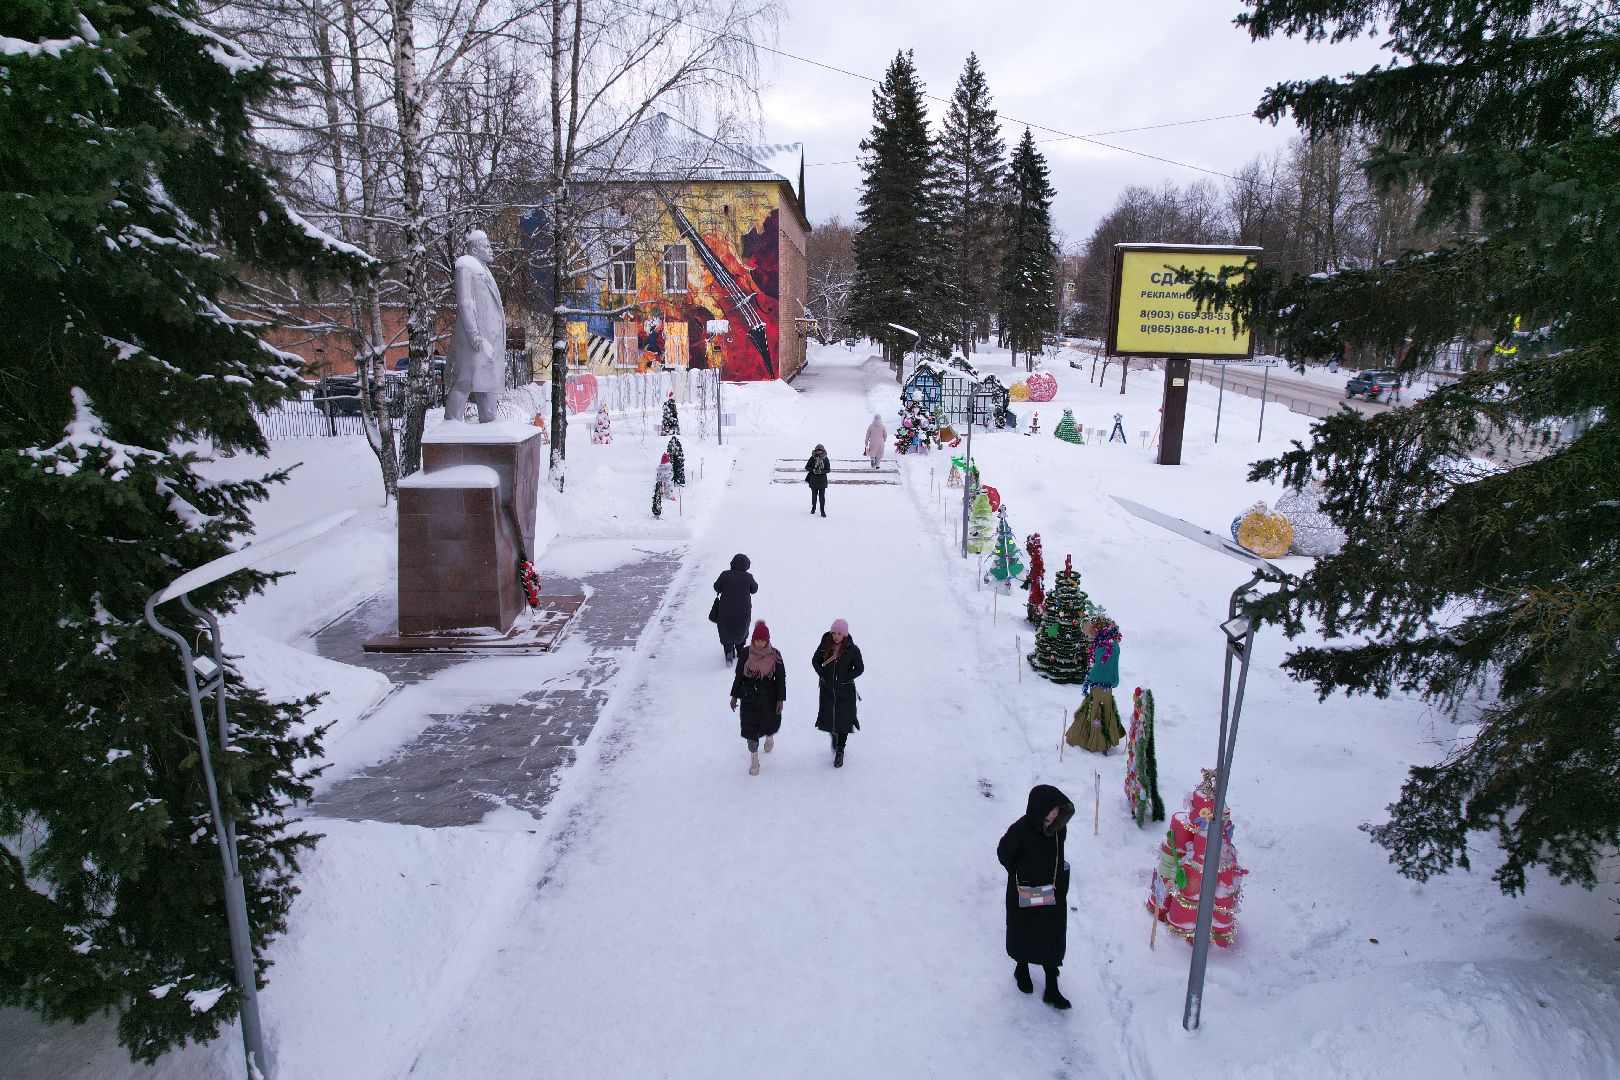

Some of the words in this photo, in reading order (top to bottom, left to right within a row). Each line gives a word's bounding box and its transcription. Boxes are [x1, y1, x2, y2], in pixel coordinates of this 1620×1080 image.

[1140, 290, 1201, 300] РЕКЛАМНО
[1139, 309, 1174, 320] 8(903)
[1177, 311, 1231, 321] 669-38-53
[1140, 324, 1227, 336] 8(965)386-81-11
